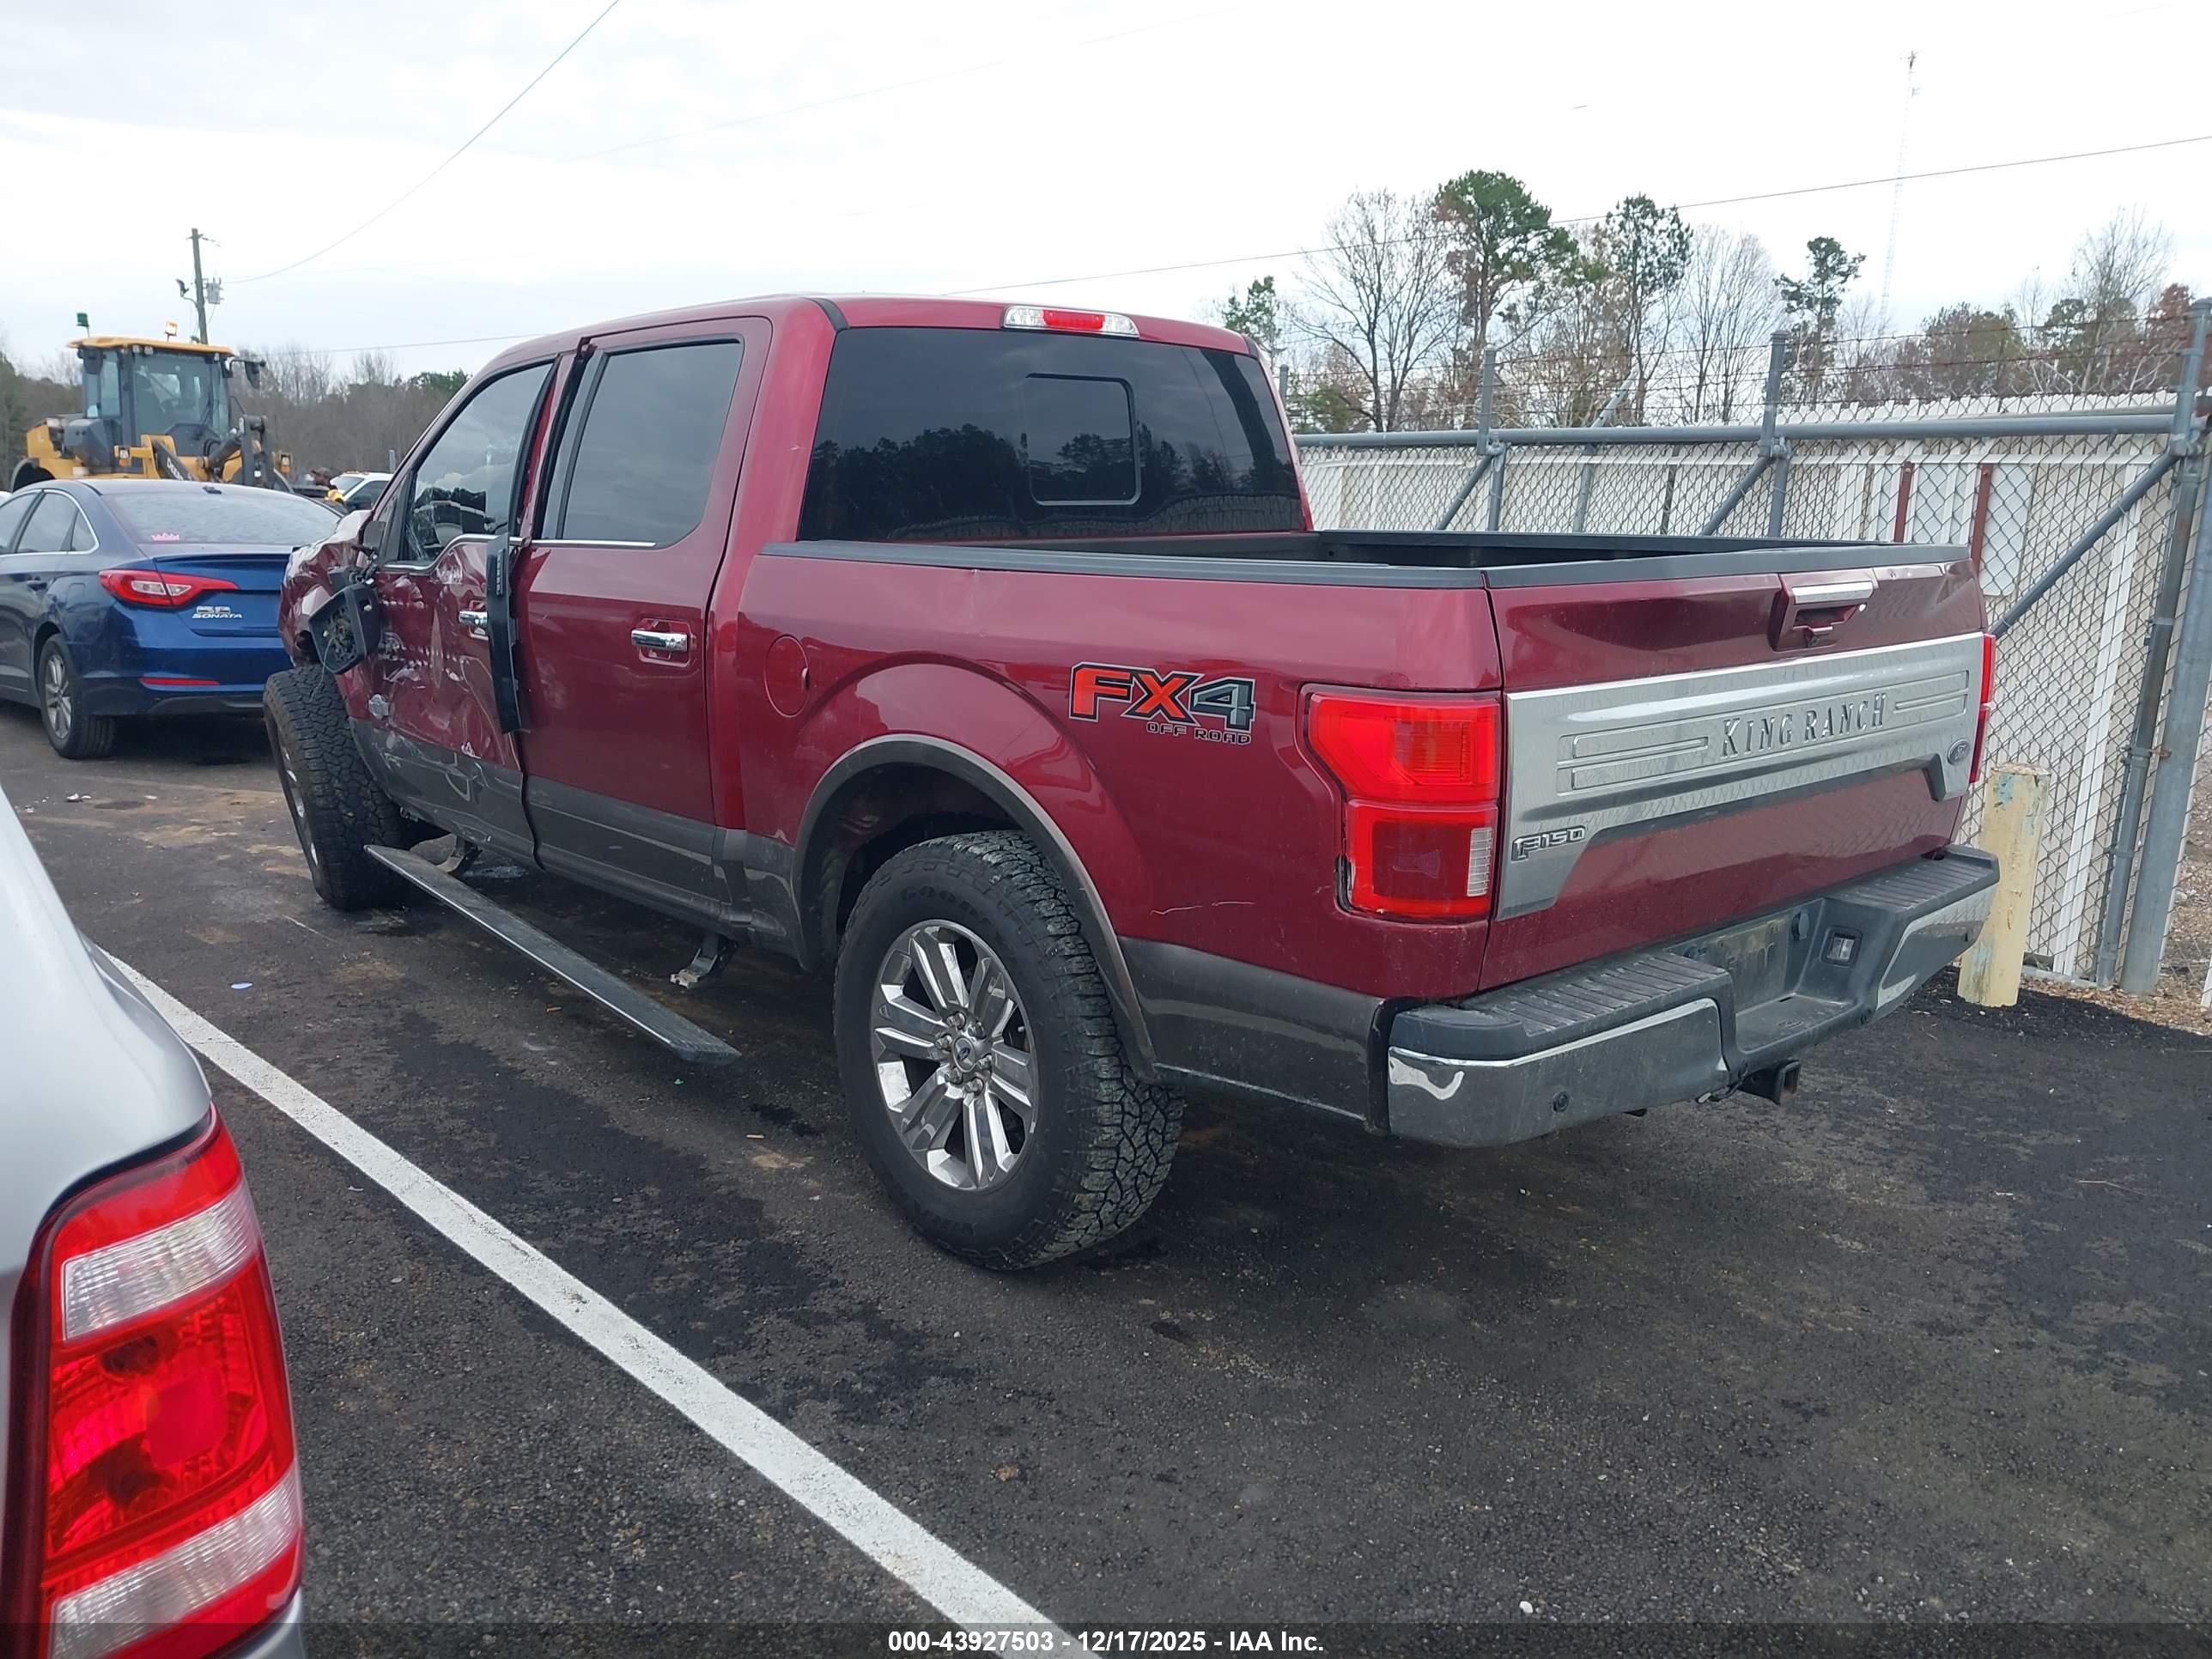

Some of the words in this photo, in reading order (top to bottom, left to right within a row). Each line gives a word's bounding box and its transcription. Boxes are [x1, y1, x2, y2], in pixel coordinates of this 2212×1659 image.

[1069, 661, 1256, 733] FX4
[1720, 714, 1794, 758] KING
[1804, 693, 1887, 743] RANCH
[1146, 721, 1187, 737] OFF
[1194, 726, 1252, 745] ROAD
